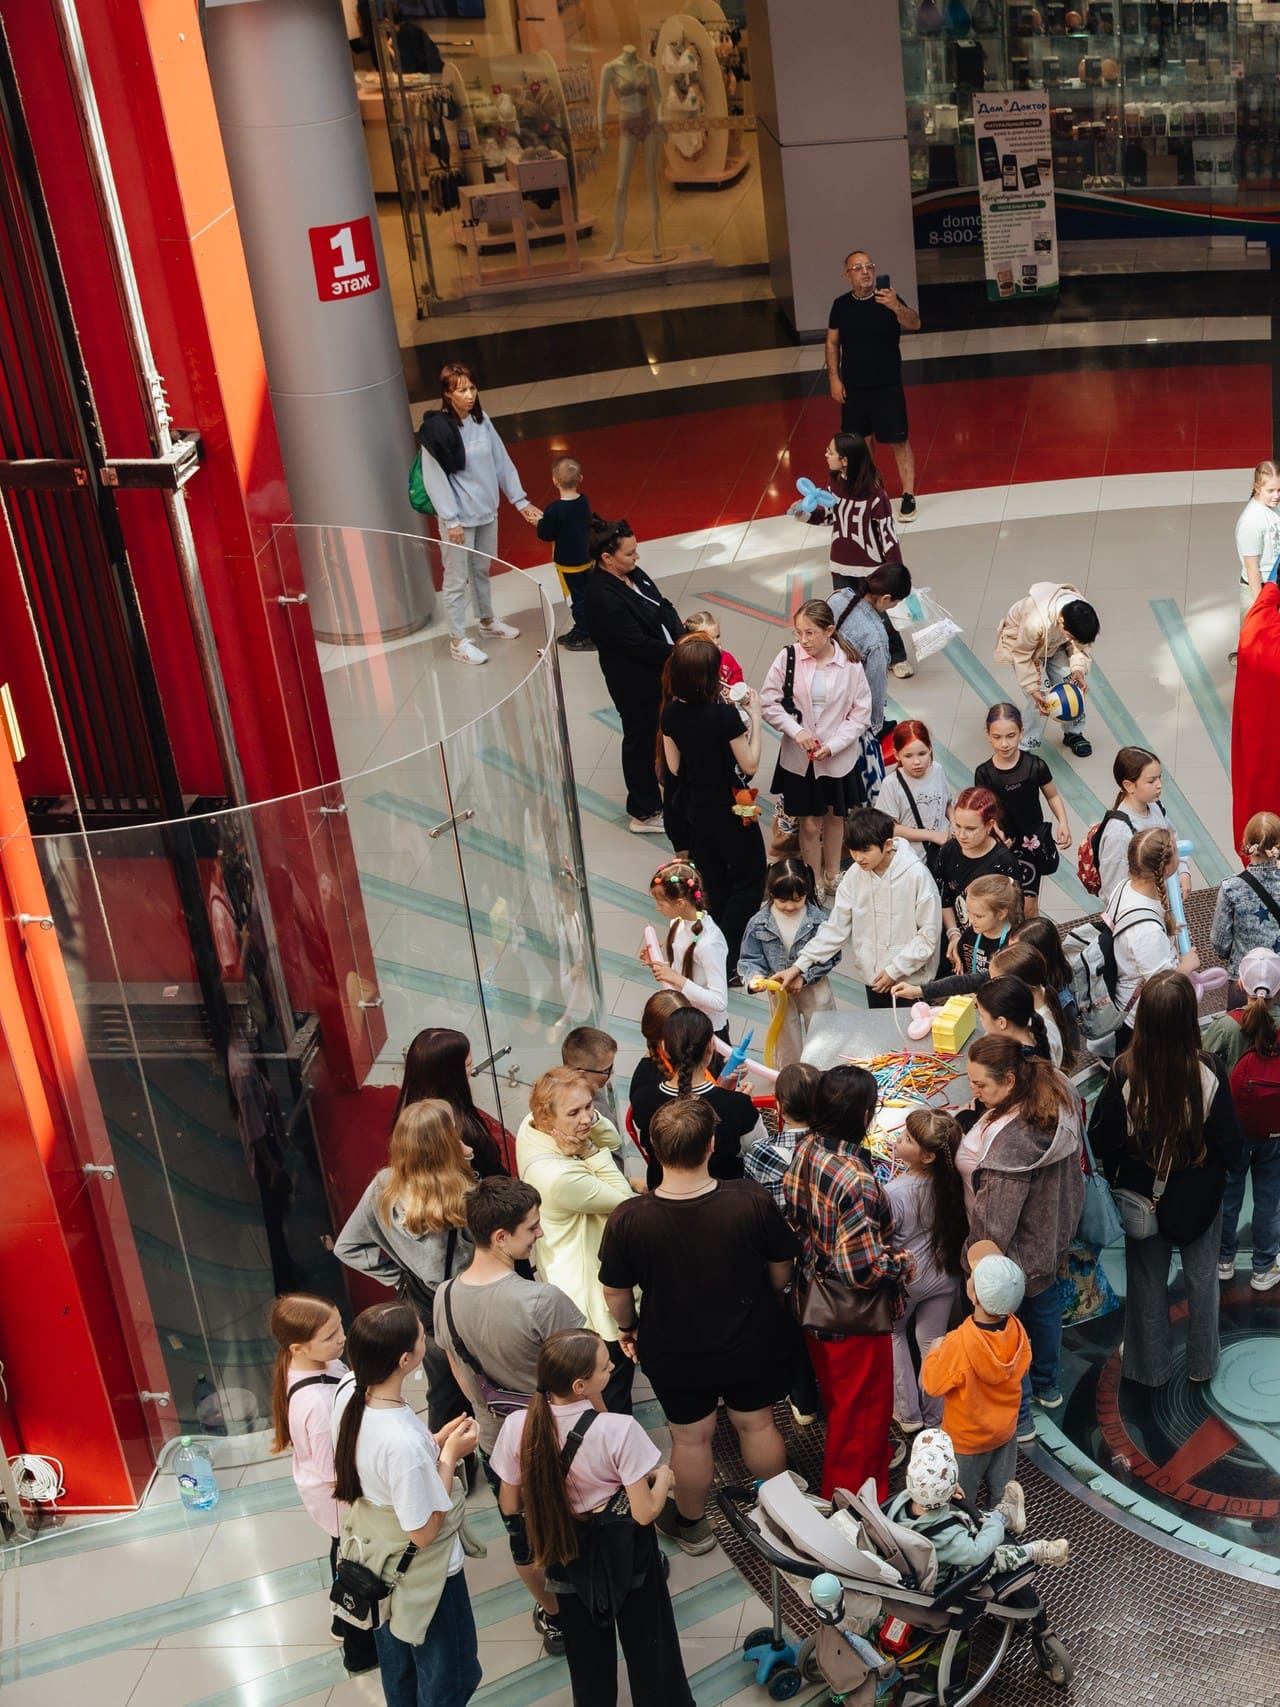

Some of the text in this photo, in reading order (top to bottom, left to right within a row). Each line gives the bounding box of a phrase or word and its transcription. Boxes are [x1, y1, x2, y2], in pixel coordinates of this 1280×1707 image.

[978, 101, 1047, 113] Дом Доктор
[330, 227, 366, 278] 1
[331, 274, 372, 295] этаж
